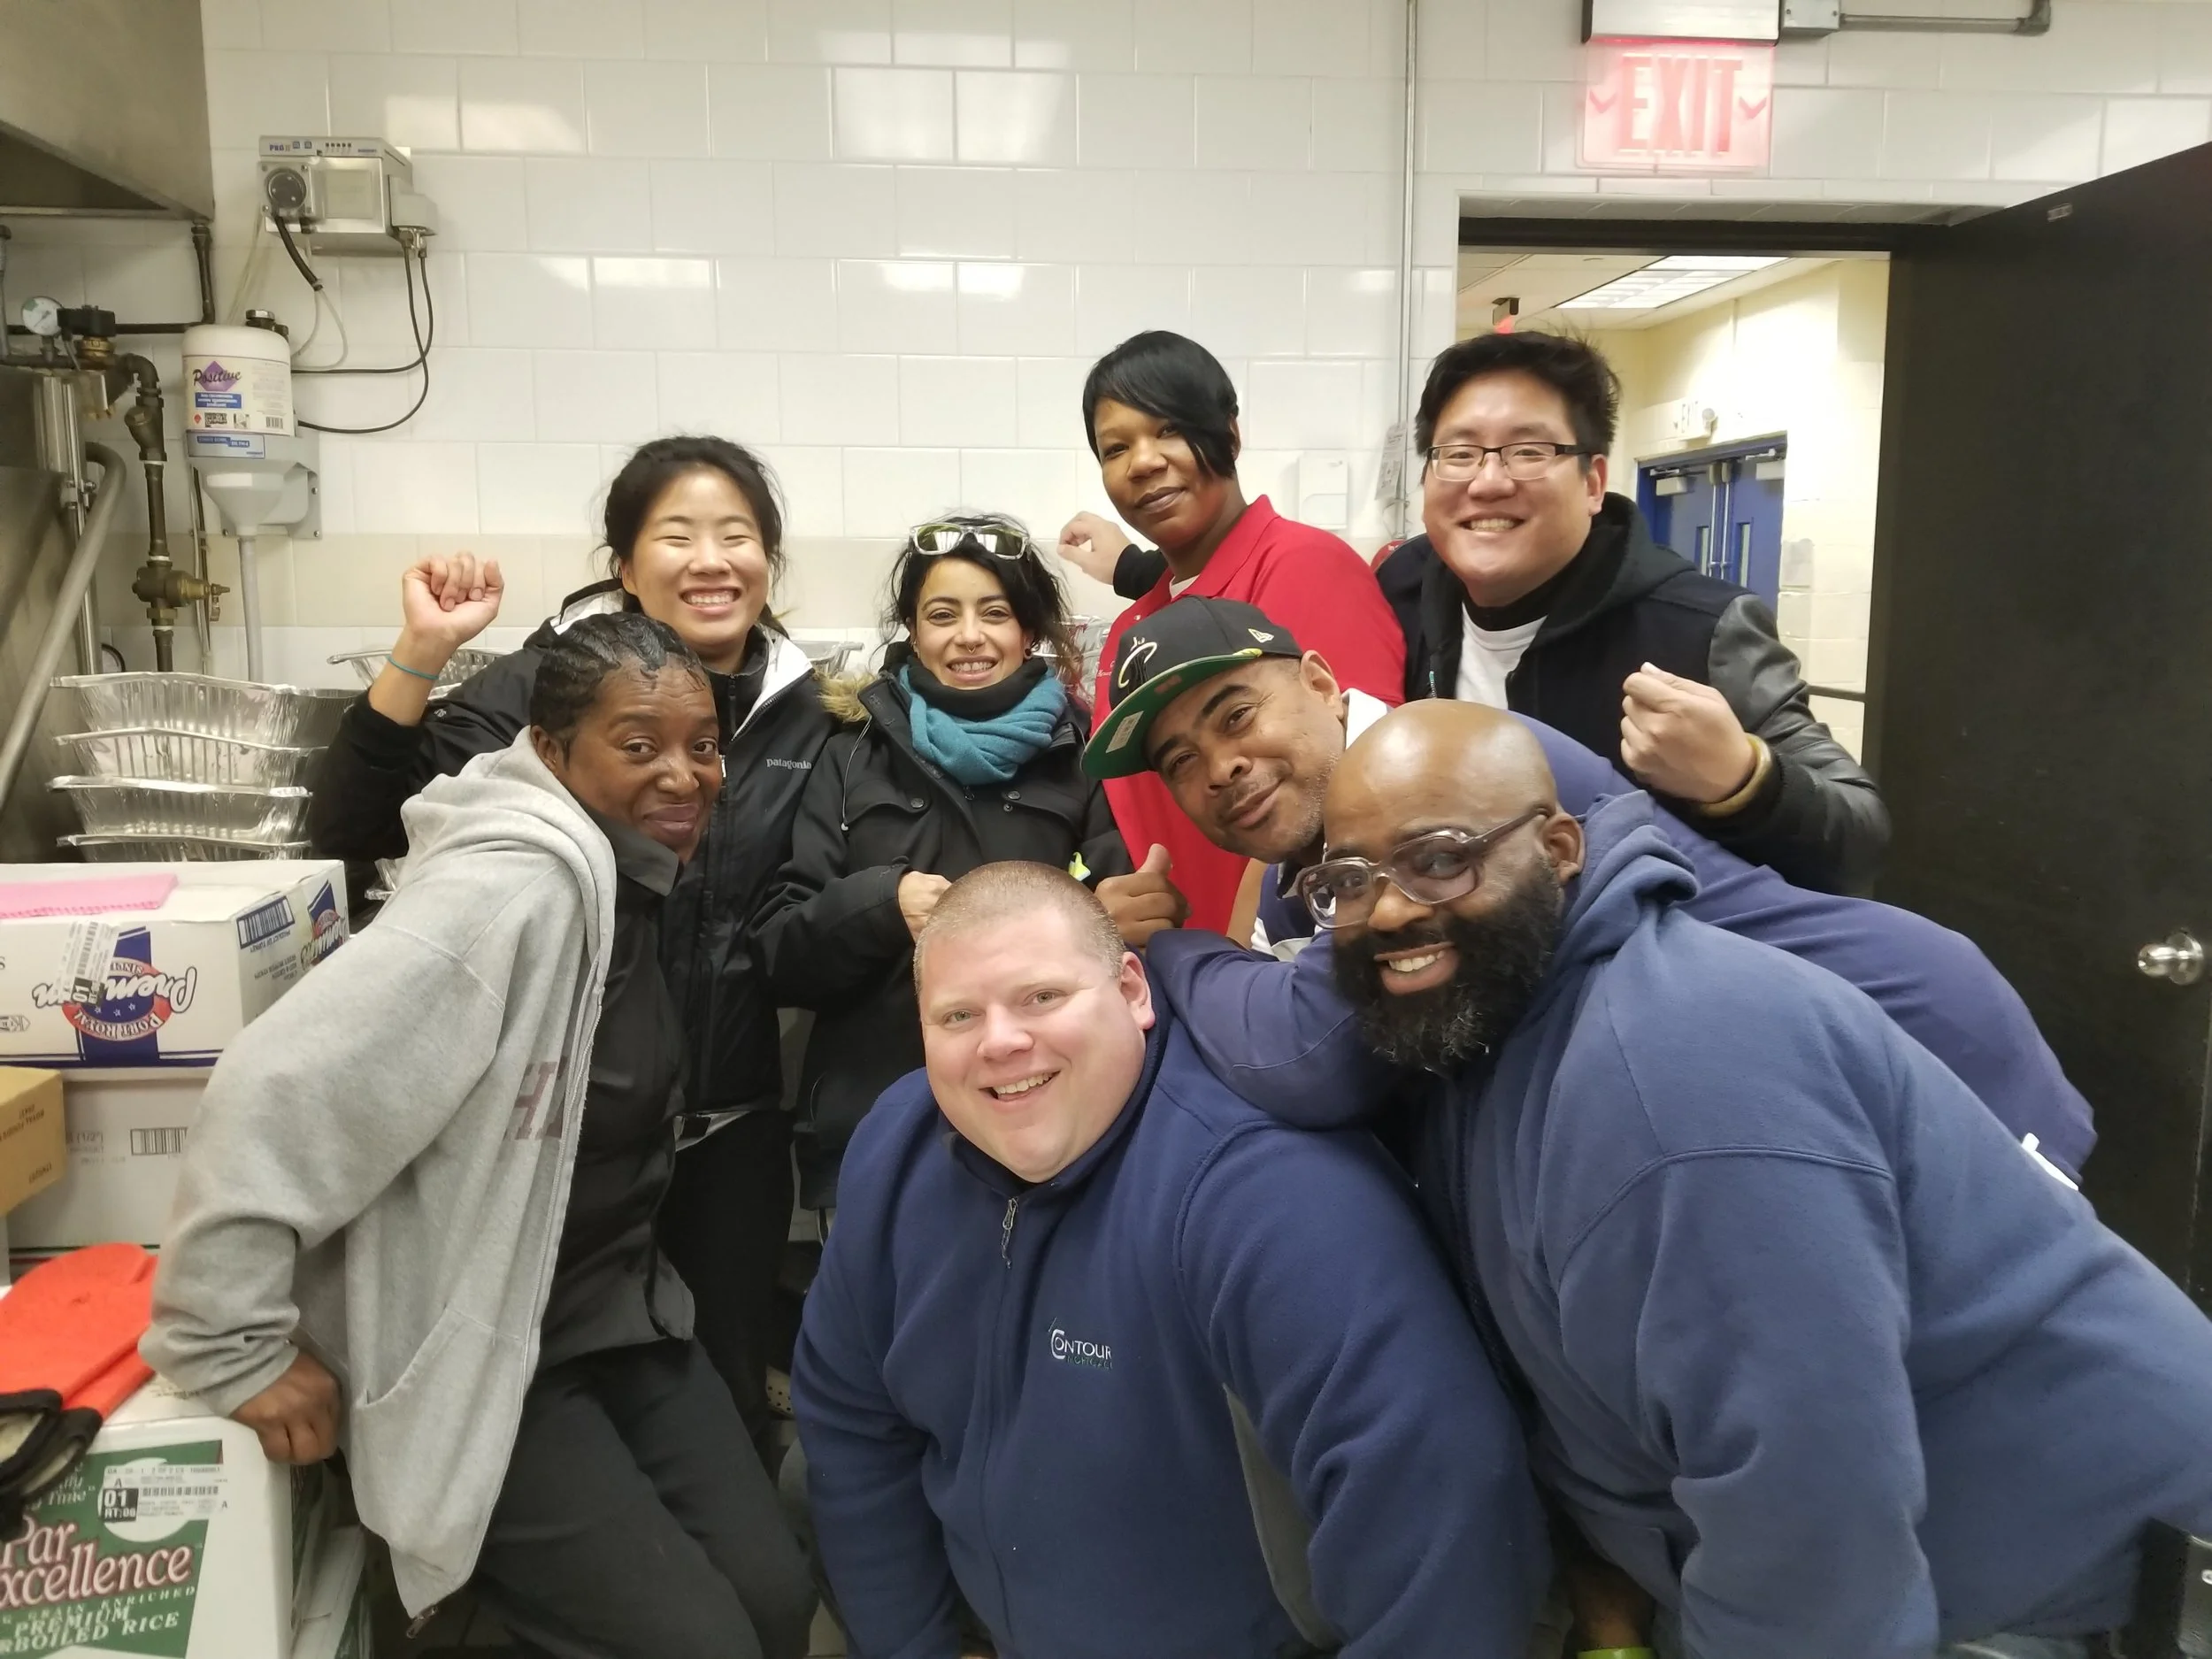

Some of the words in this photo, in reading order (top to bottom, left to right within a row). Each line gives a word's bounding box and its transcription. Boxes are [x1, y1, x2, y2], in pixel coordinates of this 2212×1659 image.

[1618, 55, 1742, 153] EXIT
[192, 369, 242, 386] Positive
[766, 758, 812, 770] patagonia
[32, 966, 198, 1014] Premm
[73, 1009, 119, 1040] ROYAL
[119, 1013, 165, 1037] PORT
[1050, 1329, 1113, 1360] CONTOUR
[104, 1489, 127, 1508] 01
[2, 1514, 76, 1569] Par
[0, 1542, 191, 1607] xcellence
[121, 1611, 180, 1636] RICE
